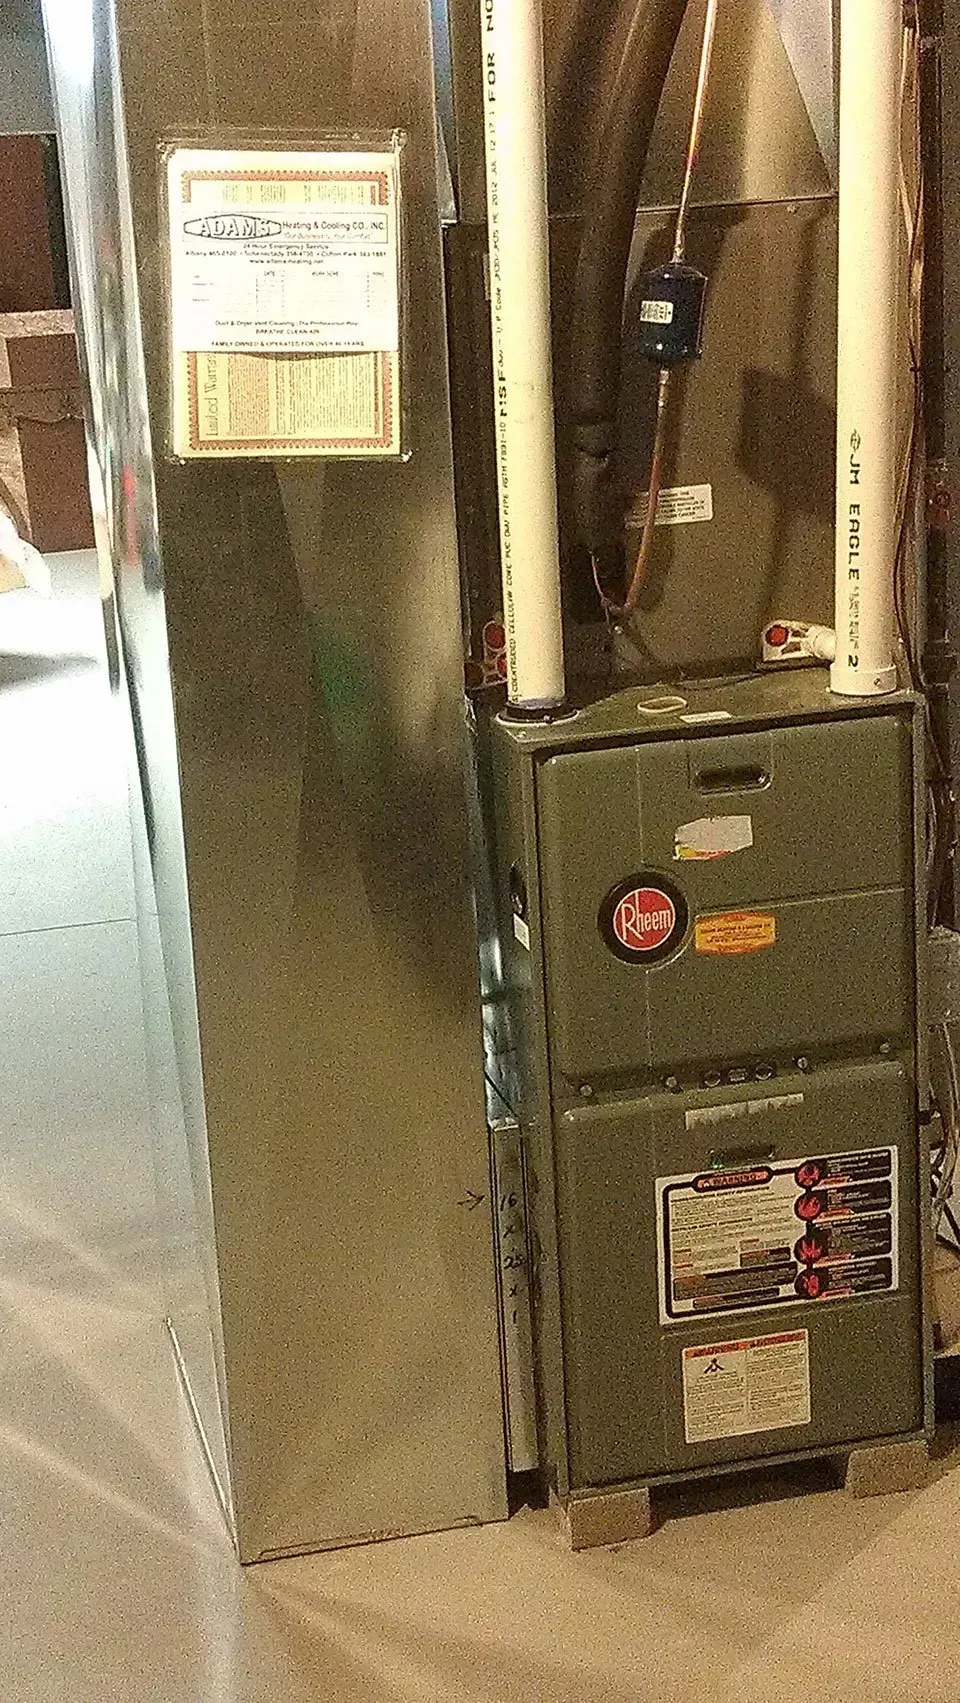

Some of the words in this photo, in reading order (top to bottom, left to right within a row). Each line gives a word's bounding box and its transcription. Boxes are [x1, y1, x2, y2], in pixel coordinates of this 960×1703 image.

[486, 52, 496, 102] FOR
[199, 219, 271, 238] ADAMS
[282, 221, 312, 231] Heating
[321, 221, 351, 231] Cooling
[850, 454, 861, 485] JM
[848, 503, 860, 580] EAGLE
[620, 890, 672, 940] Rheem
[501, 1192, 517, 1212] 16
[504, 1254, 526, 1270] 25
